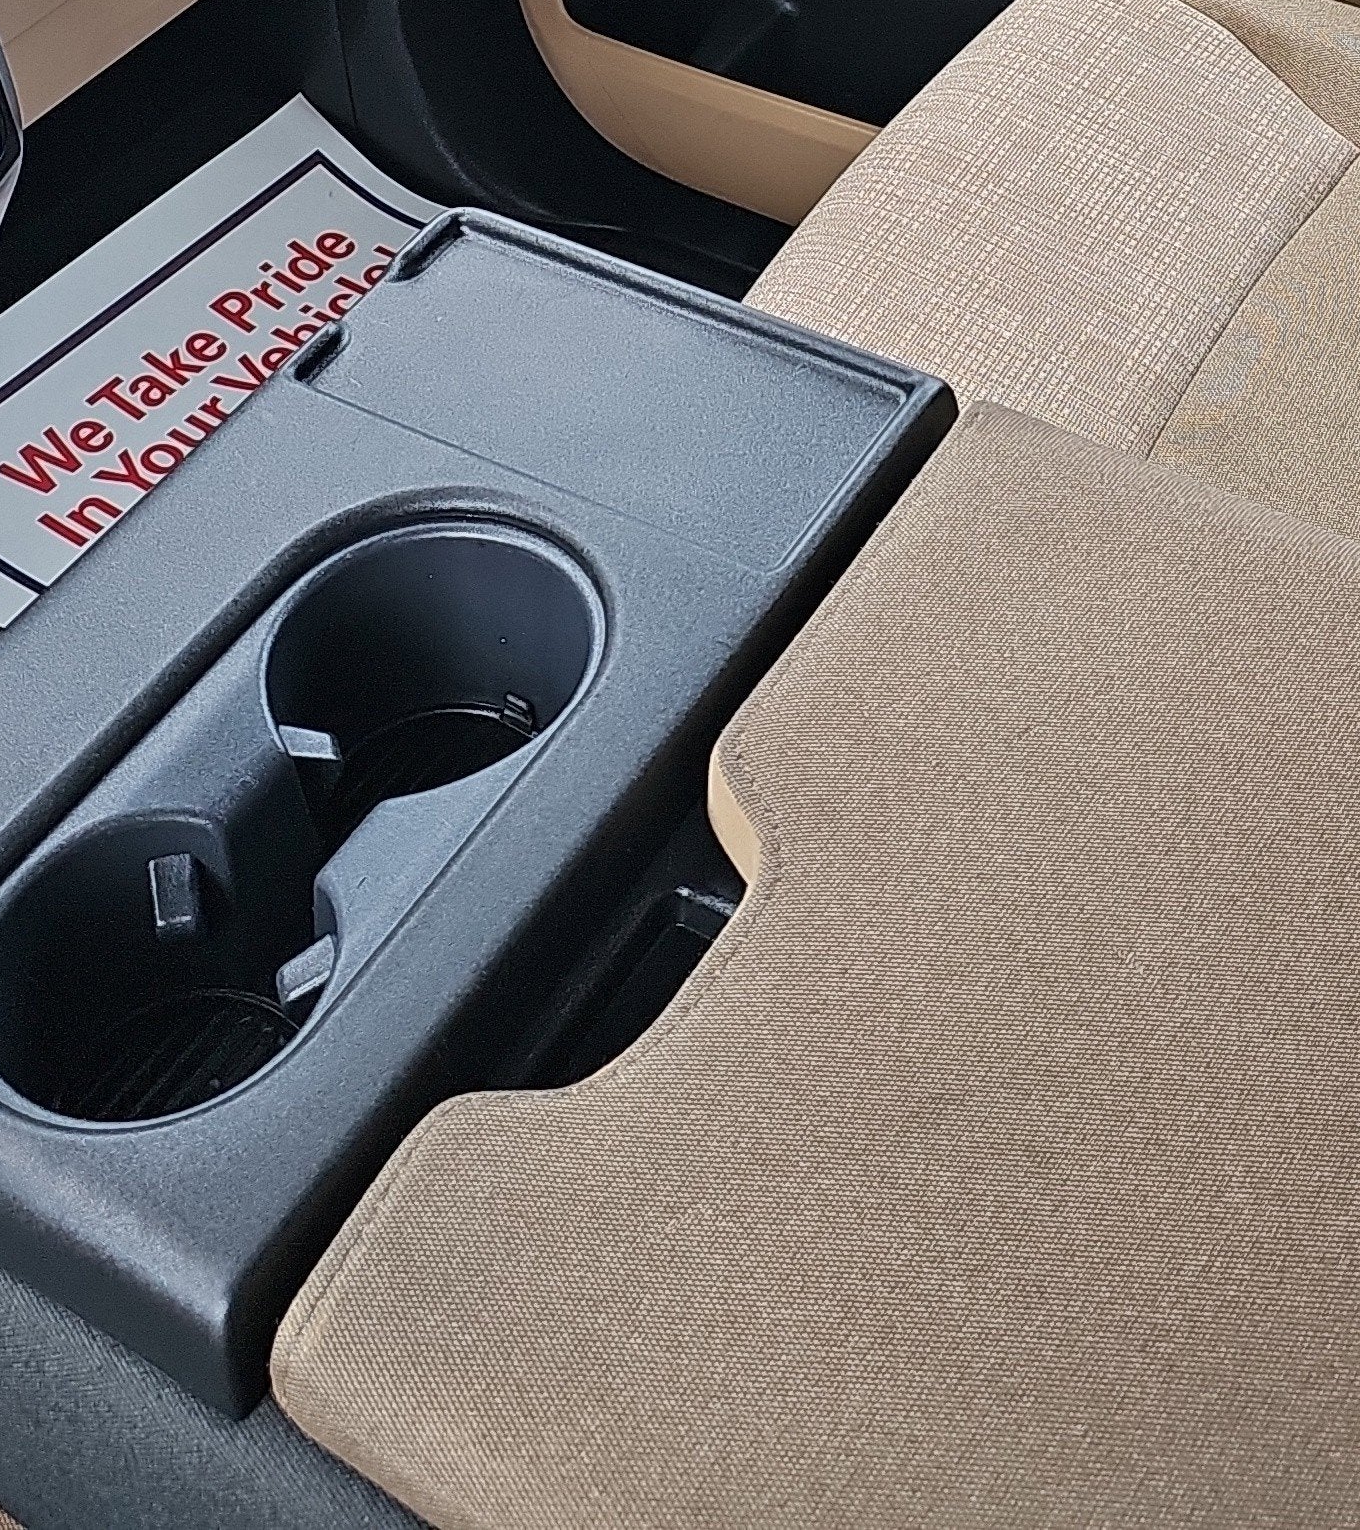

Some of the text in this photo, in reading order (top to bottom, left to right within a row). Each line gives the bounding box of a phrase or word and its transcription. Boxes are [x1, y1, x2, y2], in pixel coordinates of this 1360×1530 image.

[85, 332, 228, 421] Take
[208, 231, 356, 334] Pride
[37, 496, 124, 547] In
[90, 395, 232, 491] Your
